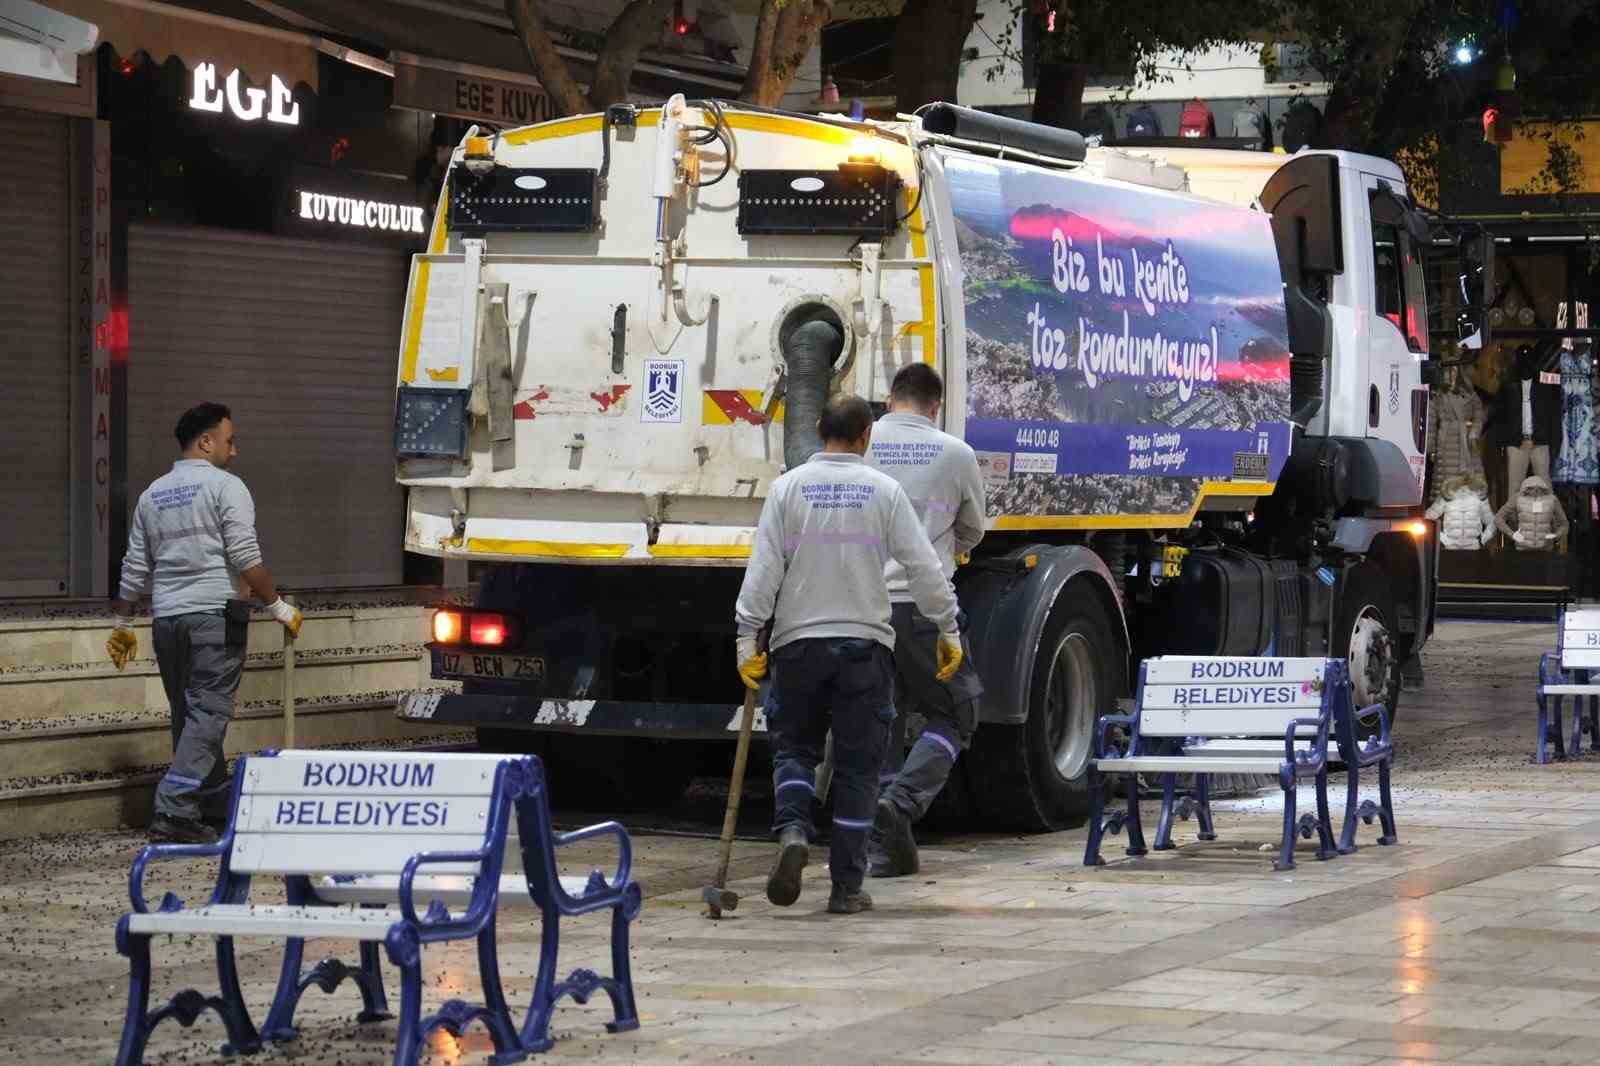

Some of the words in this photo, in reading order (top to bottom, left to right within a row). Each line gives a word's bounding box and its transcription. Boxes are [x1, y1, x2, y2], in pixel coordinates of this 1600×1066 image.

[189, 62, 299, 125] EGE
[455, 80, 495, 115] EGE
[299, 191, 424, 233] KUYUMCULUK
[1052, 227, 1089, 293] Biz
[1097, 231, 1125, 297] bu
[1132, 238, 1188, 316] kente
[96, 186, 109, 531] PHARMACY
[1027, 301, 1067, 370] toz
[1077, 309, 1218, 402] kondurmayız!
[1016, 428, 1032, 447] 444
[1034, 429, 1047, 448] 00
[1048, 430, 1060, 448] 48
[473, 656, 504, 677] BCN
[1191, 661, 1284, 678] BODRUM
[303, 763, 435, 787] BODRUM
